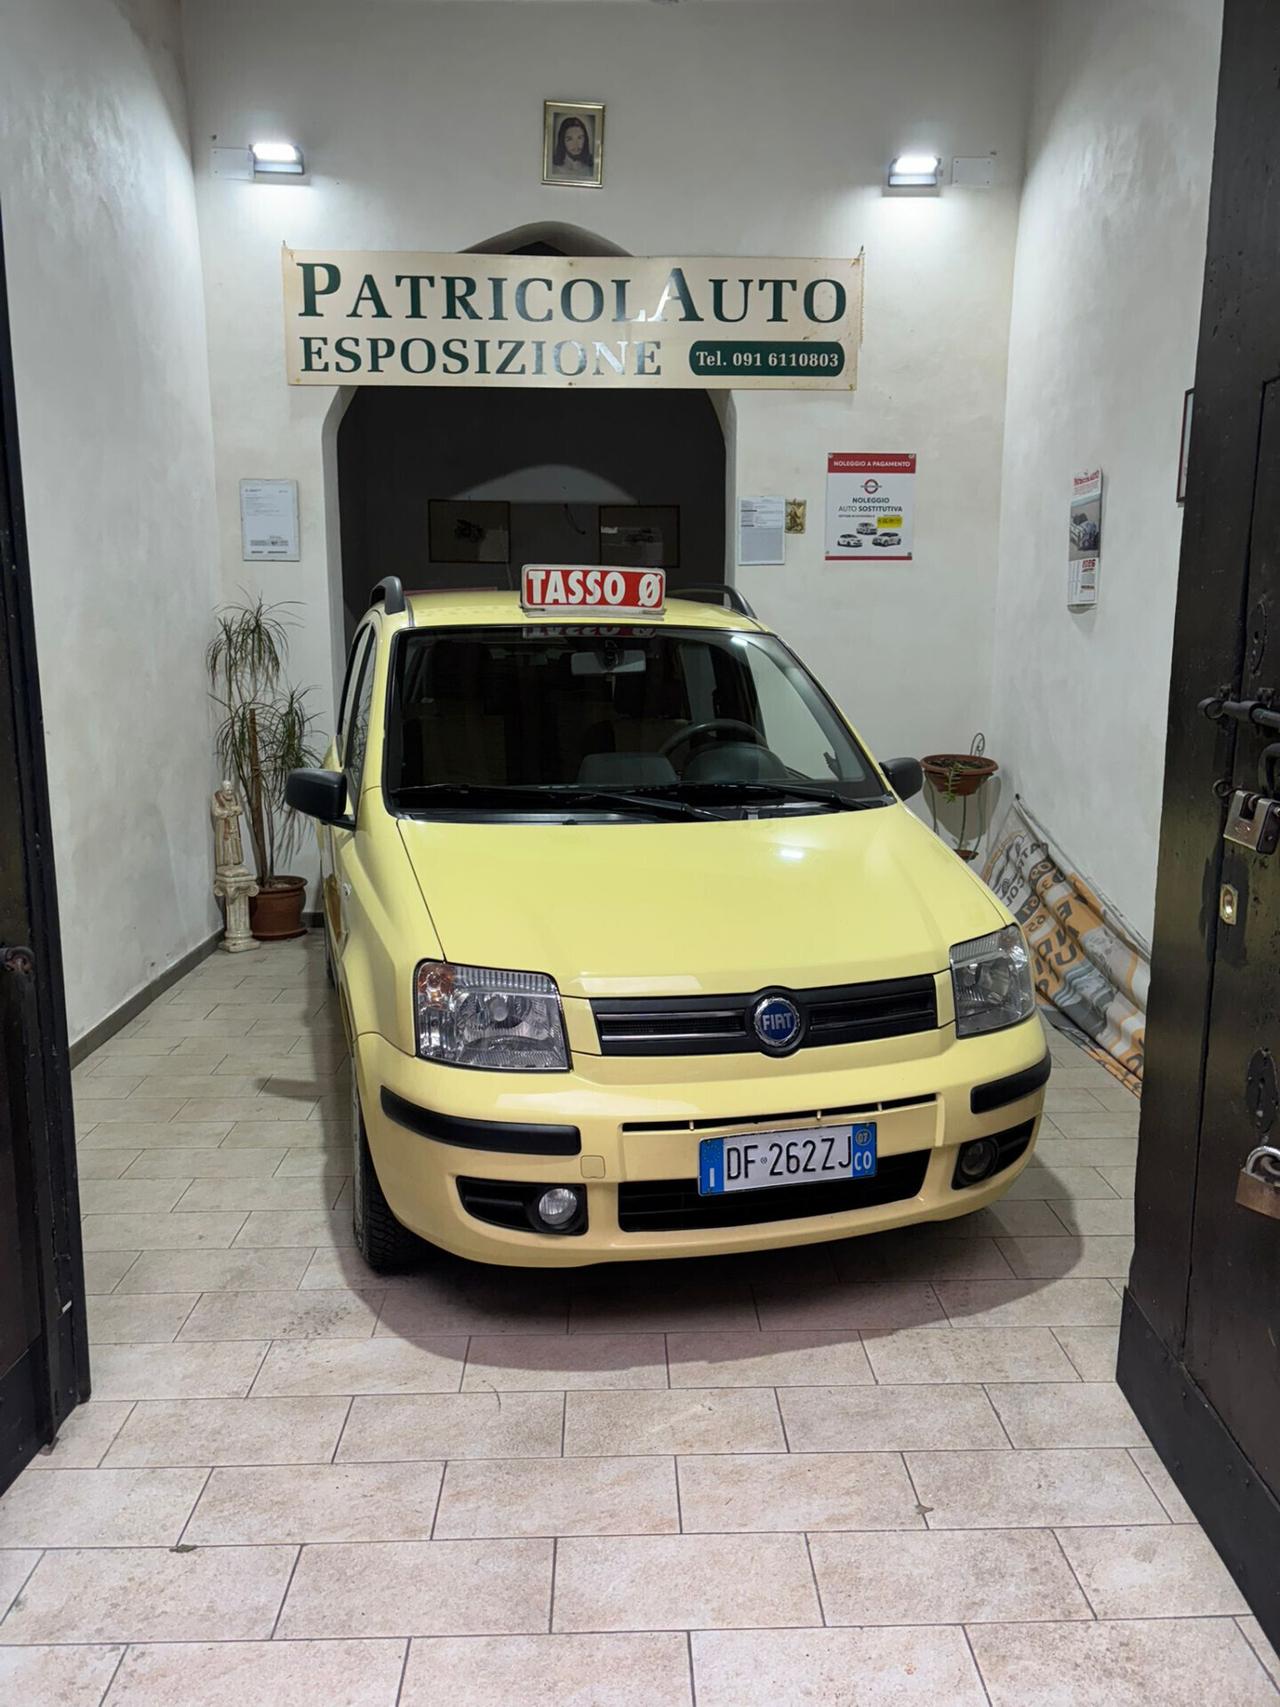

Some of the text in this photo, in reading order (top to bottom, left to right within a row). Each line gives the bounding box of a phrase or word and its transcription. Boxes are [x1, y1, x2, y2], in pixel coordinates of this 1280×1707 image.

[299, 337, 662, 376] ESPOSIZIONE
[696, 351, 839, 368] Tel. 091 6110803
[873, 460, 911, 468] PAGAMENTO
[858, 505, 903, 513] SOSTITUTIVA
[528, 570, 626, 605] TASSO
[762, 1012, 792, 1031] FIAT
[854, 1151, 873, 1171] CO
